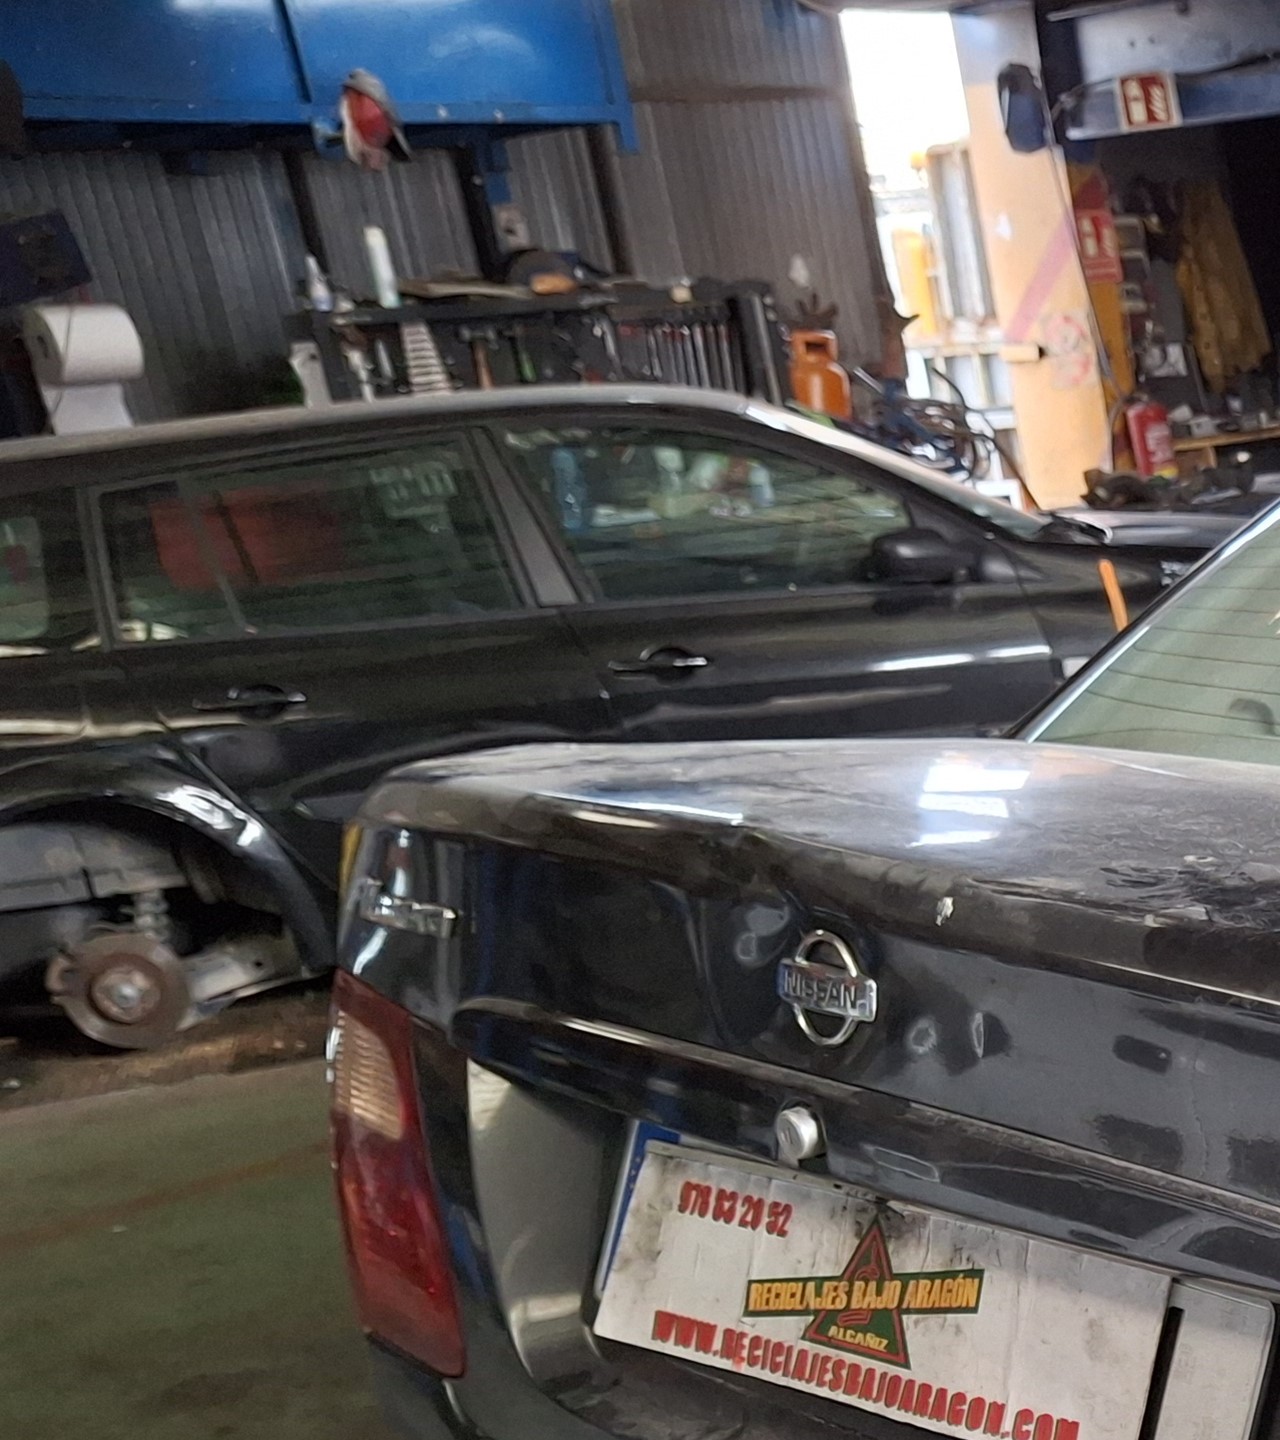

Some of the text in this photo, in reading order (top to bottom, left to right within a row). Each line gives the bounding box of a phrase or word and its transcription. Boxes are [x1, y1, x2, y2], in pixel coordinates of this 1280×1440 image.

[784, 967, 857, 1012] NISSAN
[749, 1273, 980, 1311] RECICLAJES BAJO ARAGÓN
[828, 1325, 889, 1353] ALCAÑIZ
